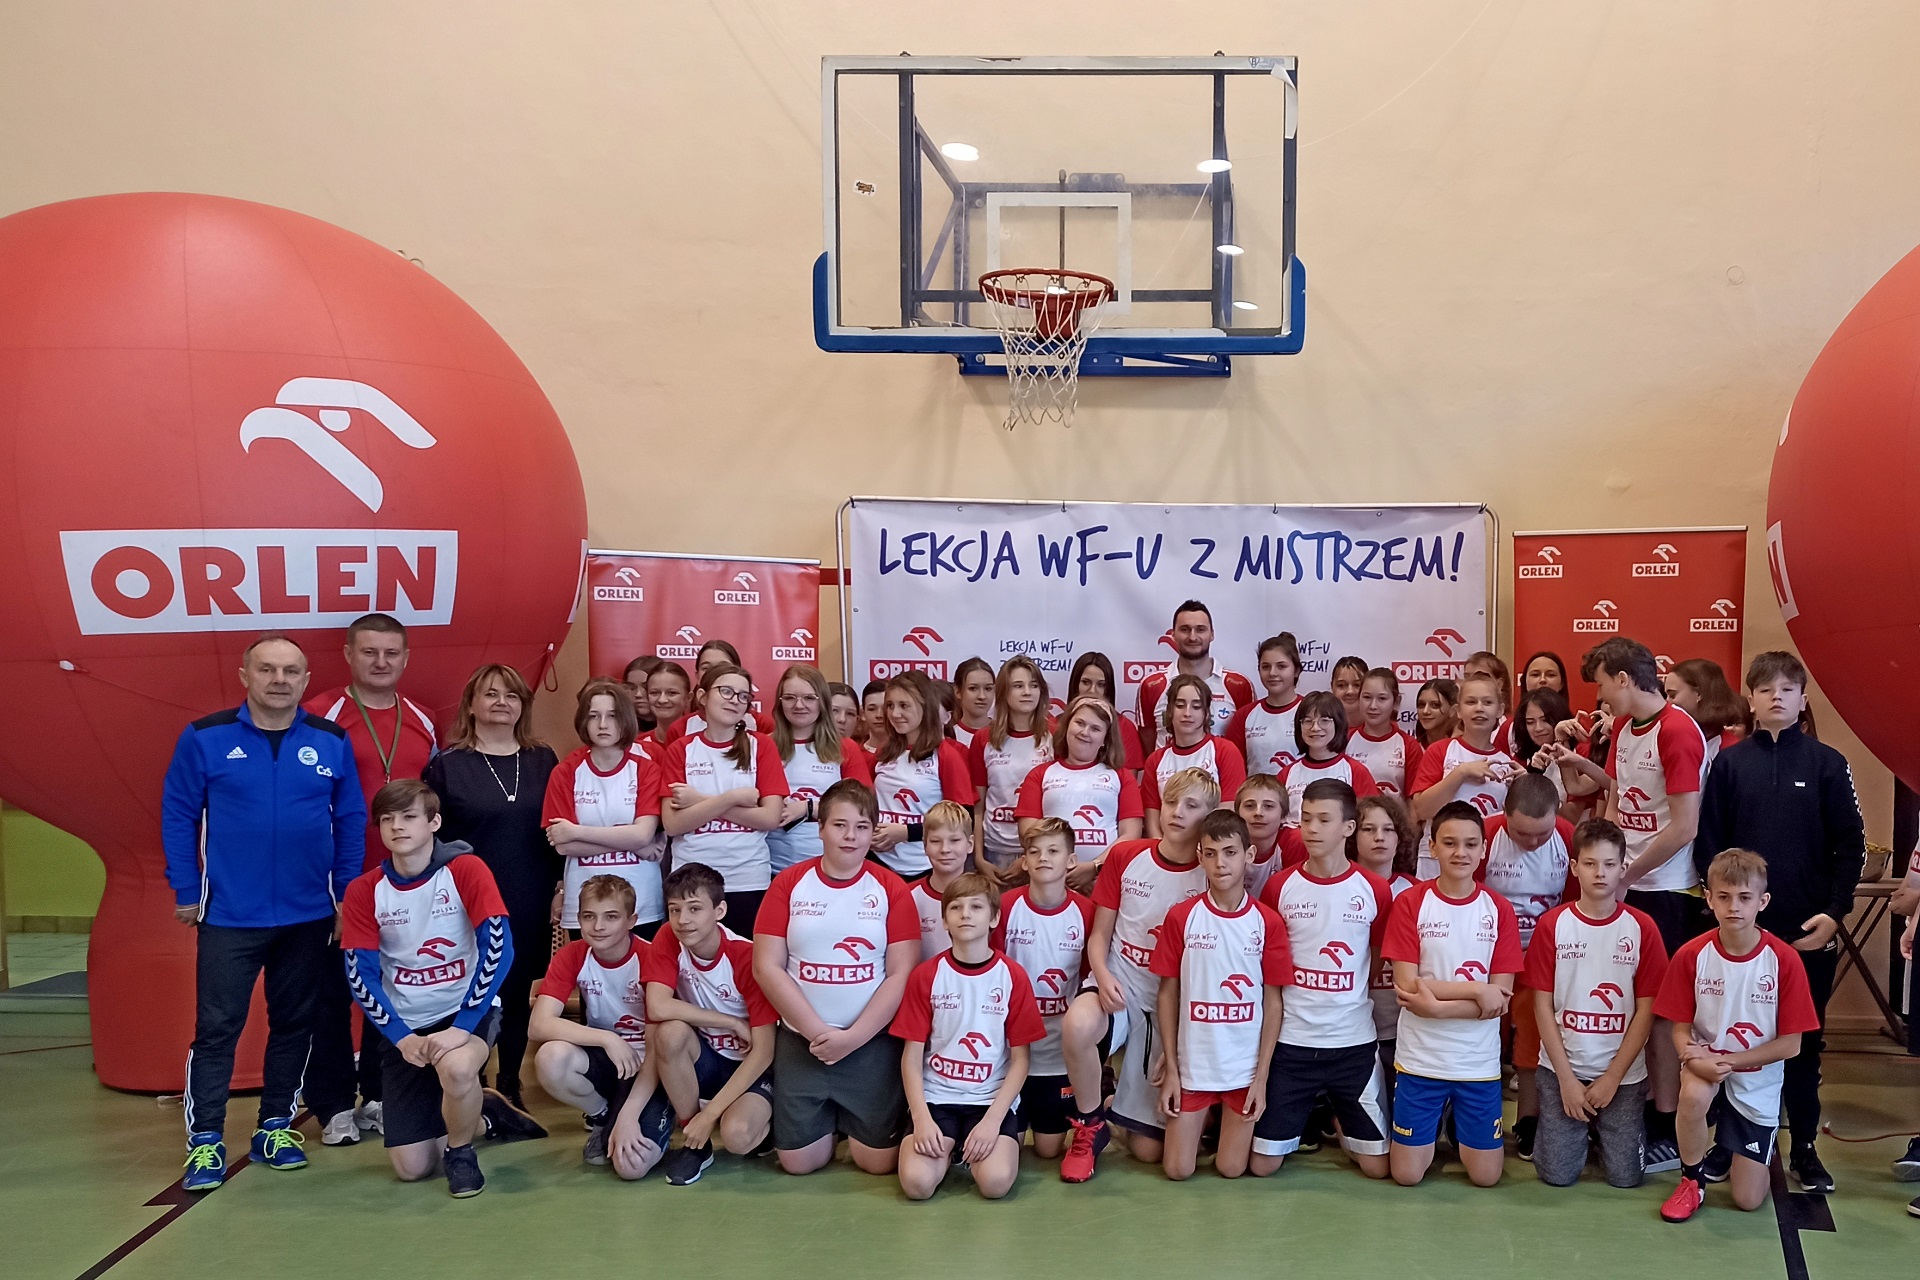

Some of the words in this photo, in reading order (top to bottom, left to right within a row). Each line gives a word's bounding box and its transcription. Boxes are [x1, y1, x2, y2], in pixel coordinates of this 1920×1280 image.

[880, 528, 1020, 582] LEKCJA
[1038, 525, 1162, 586] WF-U
[1190, 538, 1218, 578] Z
[1234, 530, 1464, 584] MISTRZEM!
[1521, 566, 1560, 578] ORLEN
[1635, 564, 1676, 576] ORLEN
[91, 545, 437, 619] ORLEN
[597, 588, 640, 600] ORLEN
[717, 592, 756, 603] ORLEN
[1576, 620, 1616, 631] ORLEN
[1692, 620, 1734, 631] ORLEN
[659, 647, 699, 658] ORLEN
[775, 648, 812, 659] ORLEN
[1000, 639, 1037, 655] LEKCJA
[1041, 639, 1074, 654] WF-U
[1299, 640, 1330, 656] WF-U
[1396, 664, 1465, 681] ORLEN
[399, 962, 462, 984] ORLEN
[802, 965, 872, 982] ORLEN
[1296, 972, 1350, 989] ORLEN
[1194, 1005, 1252, 1020] ORLEN
[1566, 1015, 1622, 1032] ORLEN
[932, 1060, 989, 1080] ORLEN
